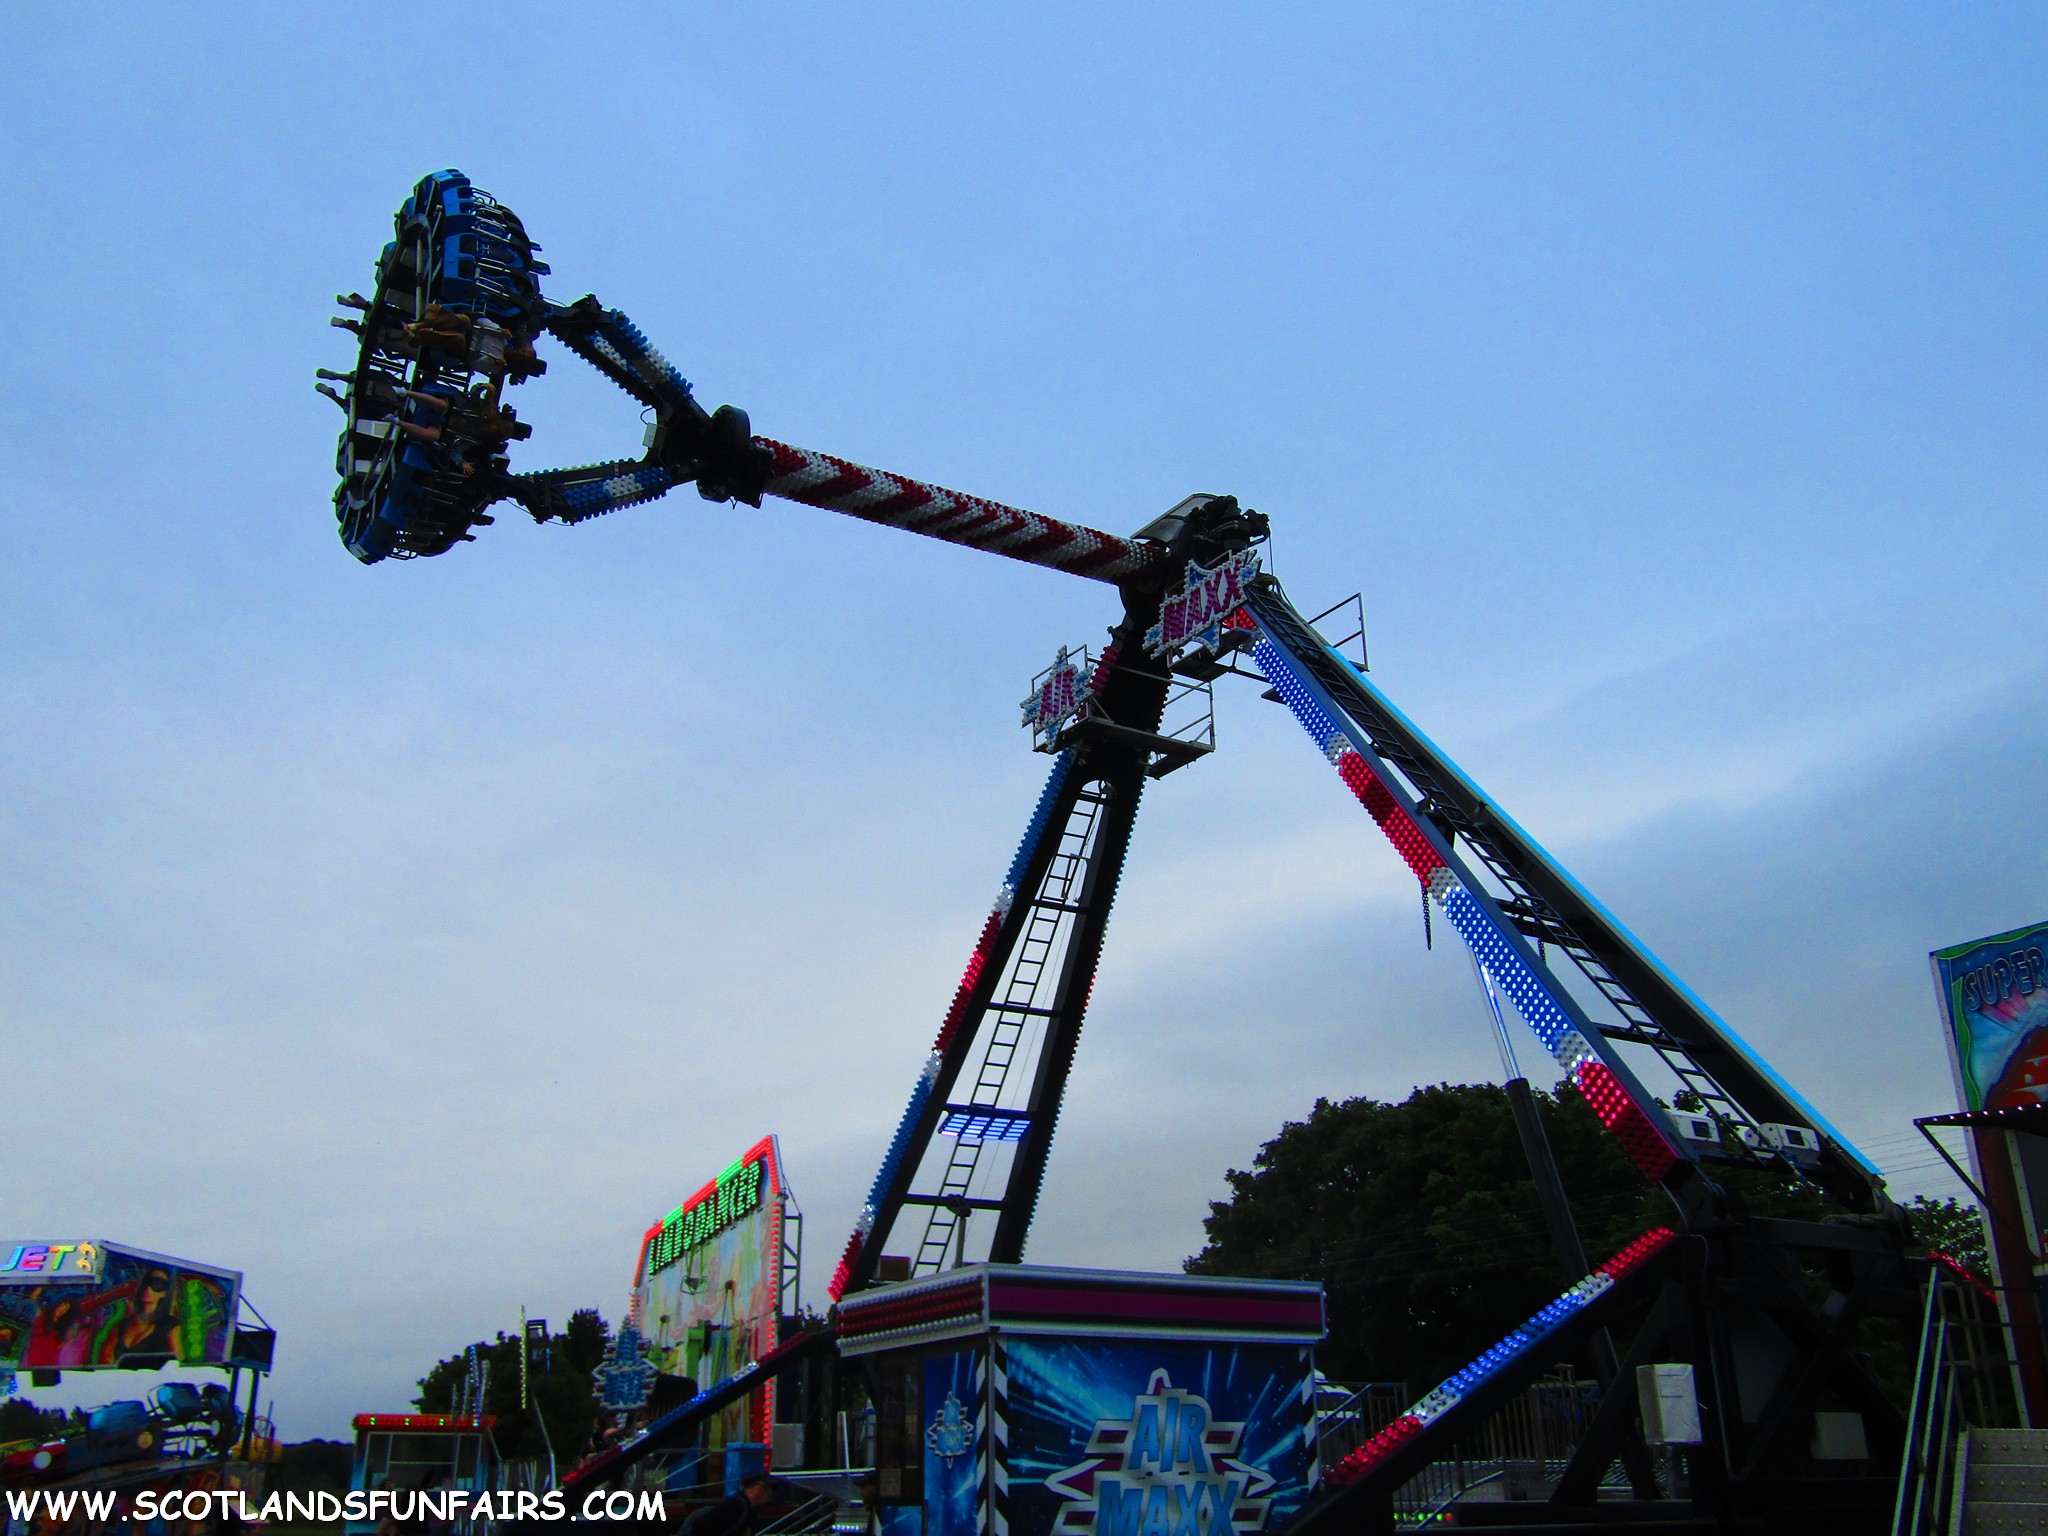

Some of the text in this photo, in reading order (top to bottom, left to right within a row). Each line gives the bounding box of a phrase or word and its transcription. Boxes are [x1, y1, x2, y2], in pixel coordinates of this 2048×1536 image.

[1162, 558, 1242, 645] MAXX
[1038, 668, 1075, 724] AIR
[1964, 946, 2048, 1011] SUPER
[0, 1245, 76, 1271] JET
[1129, 1397, 1208, 1473] AIR
[1096, 1480, 1240, 1536] MAXX
